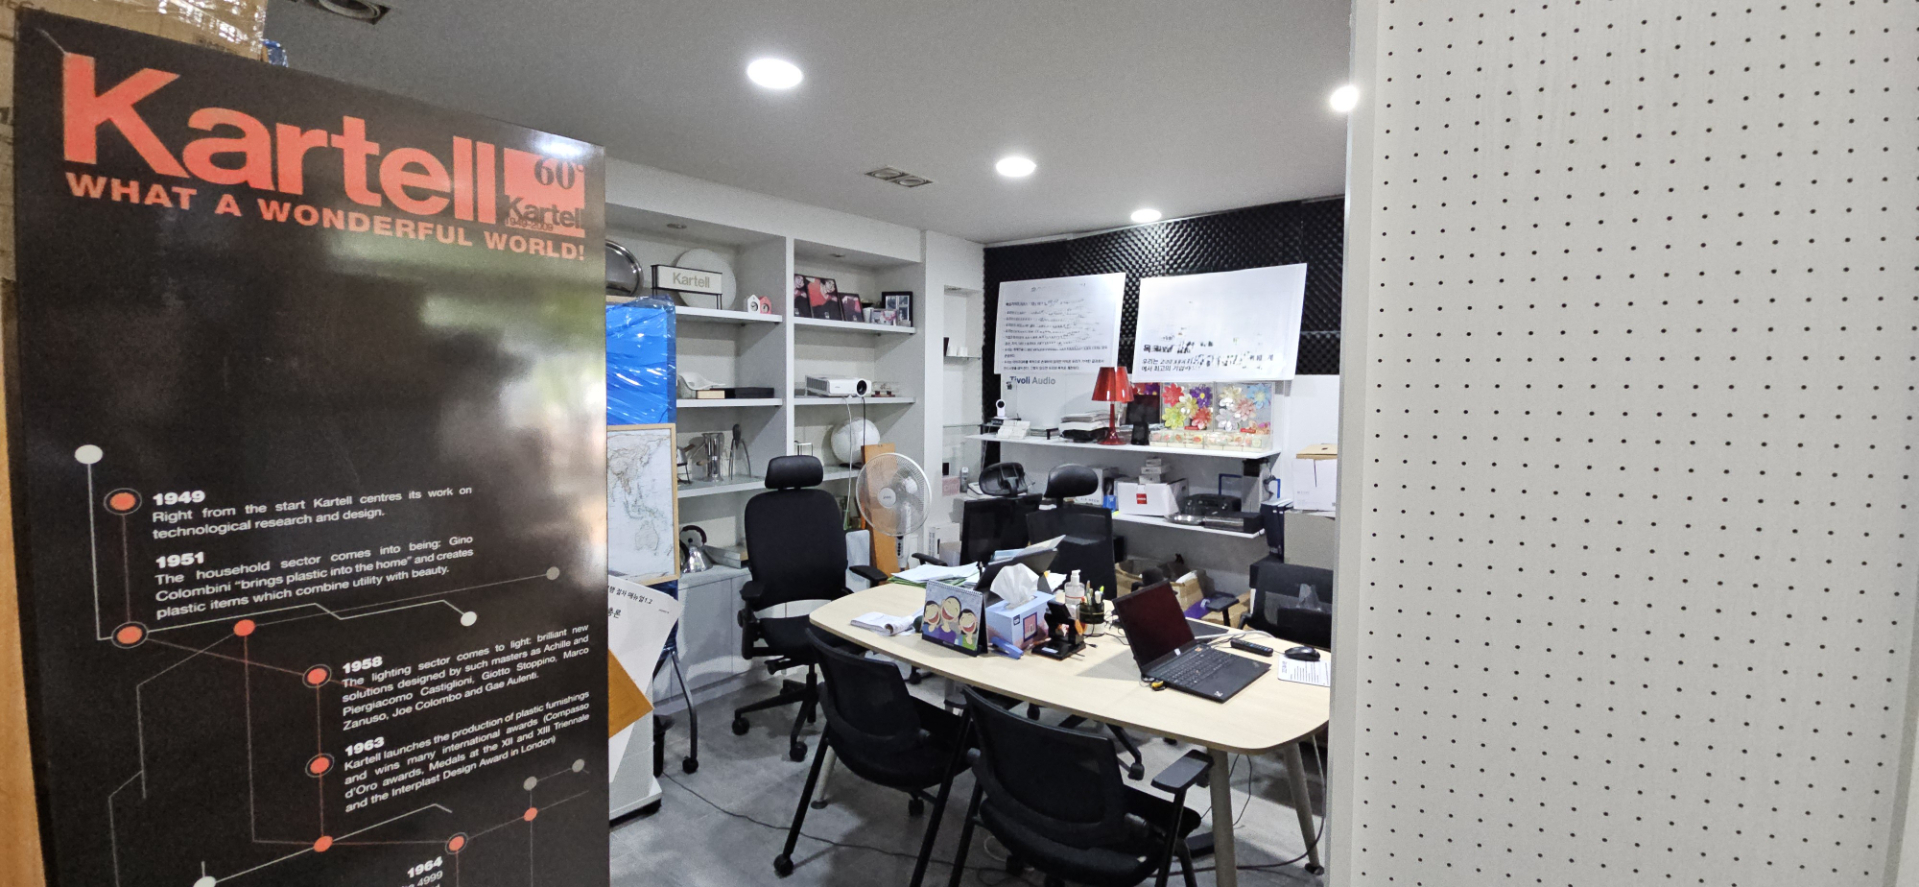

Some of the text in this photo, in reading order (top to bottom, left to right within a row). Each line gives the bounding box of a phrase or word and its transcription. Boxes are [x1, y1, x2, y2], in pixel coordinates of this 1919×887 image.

[63, 52, 496, 224] Kartell
[65, 172, 585, 261] WHAT A WONDERFUL WORLD!
[672, 272, 710, 288] Kartell
[1010, 376, 1056, 385] Tivoli Audio
[152, 487, 472, 524] Right from the start Kartell centres its work on
[152, 508, 385, 539] technological research and design.
[153, 490, 206, 505] 1949
[154, 536, 473, 585] The household sector comes into being: Gino
[155, 552, 205, 569] 1951
[155, 582, 232, 602] Colombini
[286, 569, 328, 585] plastic
[330, 566, 353, 576] into
[355, 562, 374, 573] the
[414, 554, 435, 564] and
[436, 549, 474, 561] creates
[156, 565, 449, 620] plastic items which combine utility with beauty.
[342, 677, 364, 688] The
[372, 666, 412, 682] lighting
[418, 657, 451, 670] sector
[456, 648, 490, 661] comes
[495, 644, 505, 652] to
[537, 629, 567, 642] brilliant
[572, 625, 589, 634] new
[342, 656, 383, 674] 1958
[342, 635, 589, 702] solutions designed by such masters as Achille and
[342, 693, 413, 717] Piergiacomo
[420, 676, 475, 696] Castiglioni,
[481, 667, 511, 680] Giotto
[563, 647, 589, 659] Marco
[343, 672, 539, 731] Zanuso, Joe Colombo and Gae Aulenti.
[344, 691, 590, 771] Kartell launches the production of plastic furnishings
[344, 702, 590, 785] and wins many international awards (Compasso
[345, 736, 385, 757] 1963
[382, 767, 424, 787] awards,
[429, 754, 466, 771] Medals
[469, 749, 479, 758] at
[482, 743, 498, 753] the
[501, 737, 513, 748] XII
[516, 731, 534, 743] and
[537, 725, 550, 737] XIII
[554, 713, 590, 730] Triennale
[345, 735, 556, 813] and the Interplast Design Award in London)
[407, 856, 443, 878] 1964
[417, 870, 443, 886] 4999
